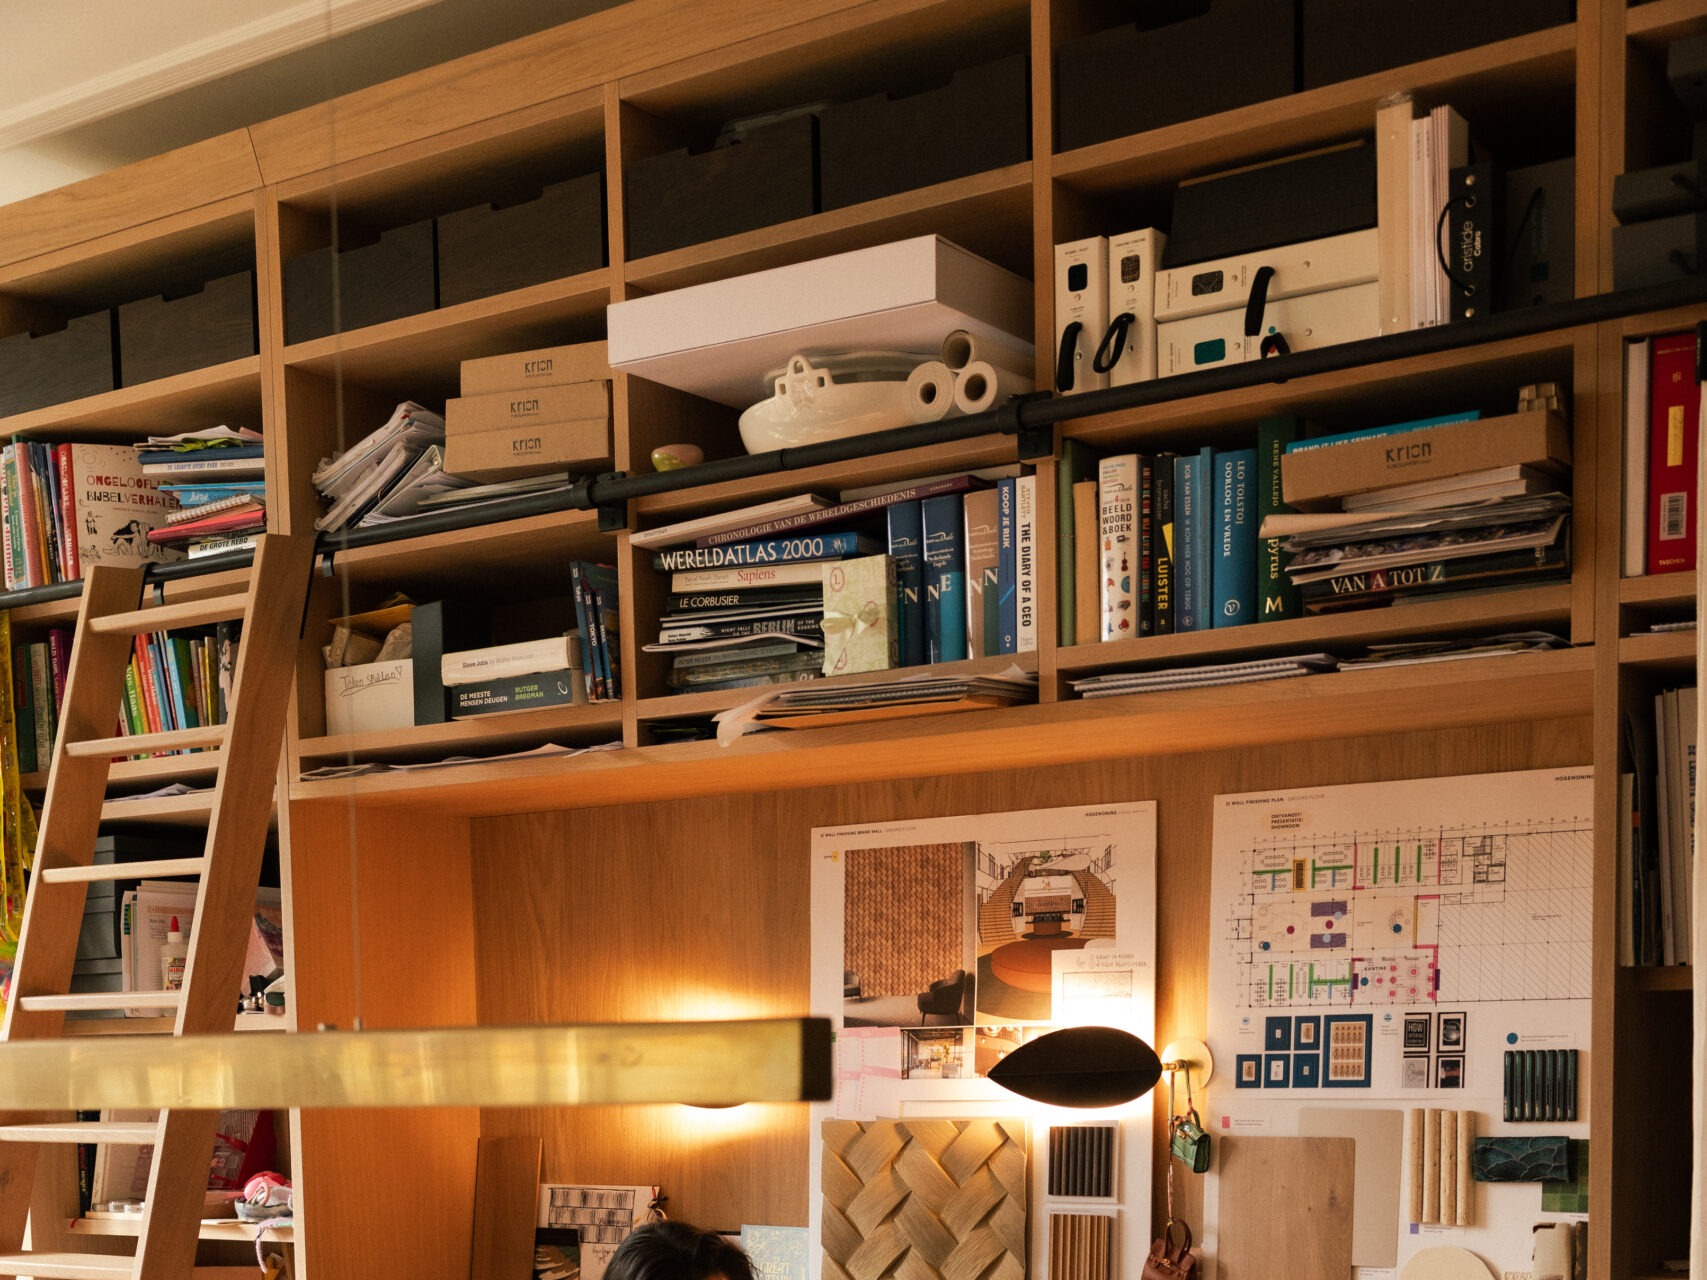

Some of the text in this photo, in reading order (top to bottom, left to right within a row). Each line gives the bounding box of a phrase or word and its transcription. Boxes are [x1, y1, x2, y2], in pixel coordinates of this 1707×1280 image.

[1460, 221, 1473, 272] aristide
[1142, 467, 1151, 489] ANTON
[1271, 439, 1280, 507] IRENE VALLEJO
[87, 475, 160, 491] ONGELOOFLI
[86, 490, 183, 510] BIJBELVERHALEN
[1114, 495, 1119, 503] 4
[1142, 489, 1151, 499] DE
[1162, 489, 1170, 510] sacha
[1234, 460, 1245, 525] LEO TOLSTOJ
[1102, 503, 1132, 515] BEELD
[1142, 499, 1151, 515] KOM
[1223, 461, 1233, 558] OORLOG EN VREDE
[707, 488, 916, 546] CHRONOLOGIE VAN DE WERELDGESCHIEDENIS
[1001, 486, 1011, 549] KOOP JE RIJK
[1102, 513, 1132, 525] WOORD
[1142, 517, 1151, 530] WIJ
[1102, 523, 1132, 535] &BOEK
[209, 540, 229, 550] GROTE
[660, 538, 824, 572] WERELDATLAS 2000
[1142, 556, 1151, 569] VAN
[1267, 538, 1282, 580] pyrus
[1658, 558, 1686, 566] TASCHEN
[737, 568, 776, 585] Sapiens
[970, 567, 999, 597] N N
[1021, 522, 1032, 627] THE DIARY OF A CEO
[1184, 577, 1191, 588] OP
[1330, 565, 1443, 594] VAN A TOT Z
[927, 574, 952, 602] N E
[1157, 557, 1169, 610] LUISTER
[574, 585, 582, 603] Tokyo
[679, 594, 740, 608] LE CORBUSIER
[903, 586, 919, 604] N
[589, 623, 597, 647] TOKYO
[599, 624, 607, 644] SEOUL
[752, 619, 795, 635] BERLIN
[462, 661, 476, 669] Steve
[459, 691, 544, 708] MENSEN DEUGEN BREGMAN
[460, 684, 539, 701] DE MEESTE RUTGER
[129, 689, 138, 717] Haas
[1687, 745, 1696, 756] DE
[1408, 1023, 1423, 1032] HGW
[759, 1260, 791, 1274] GREAT
